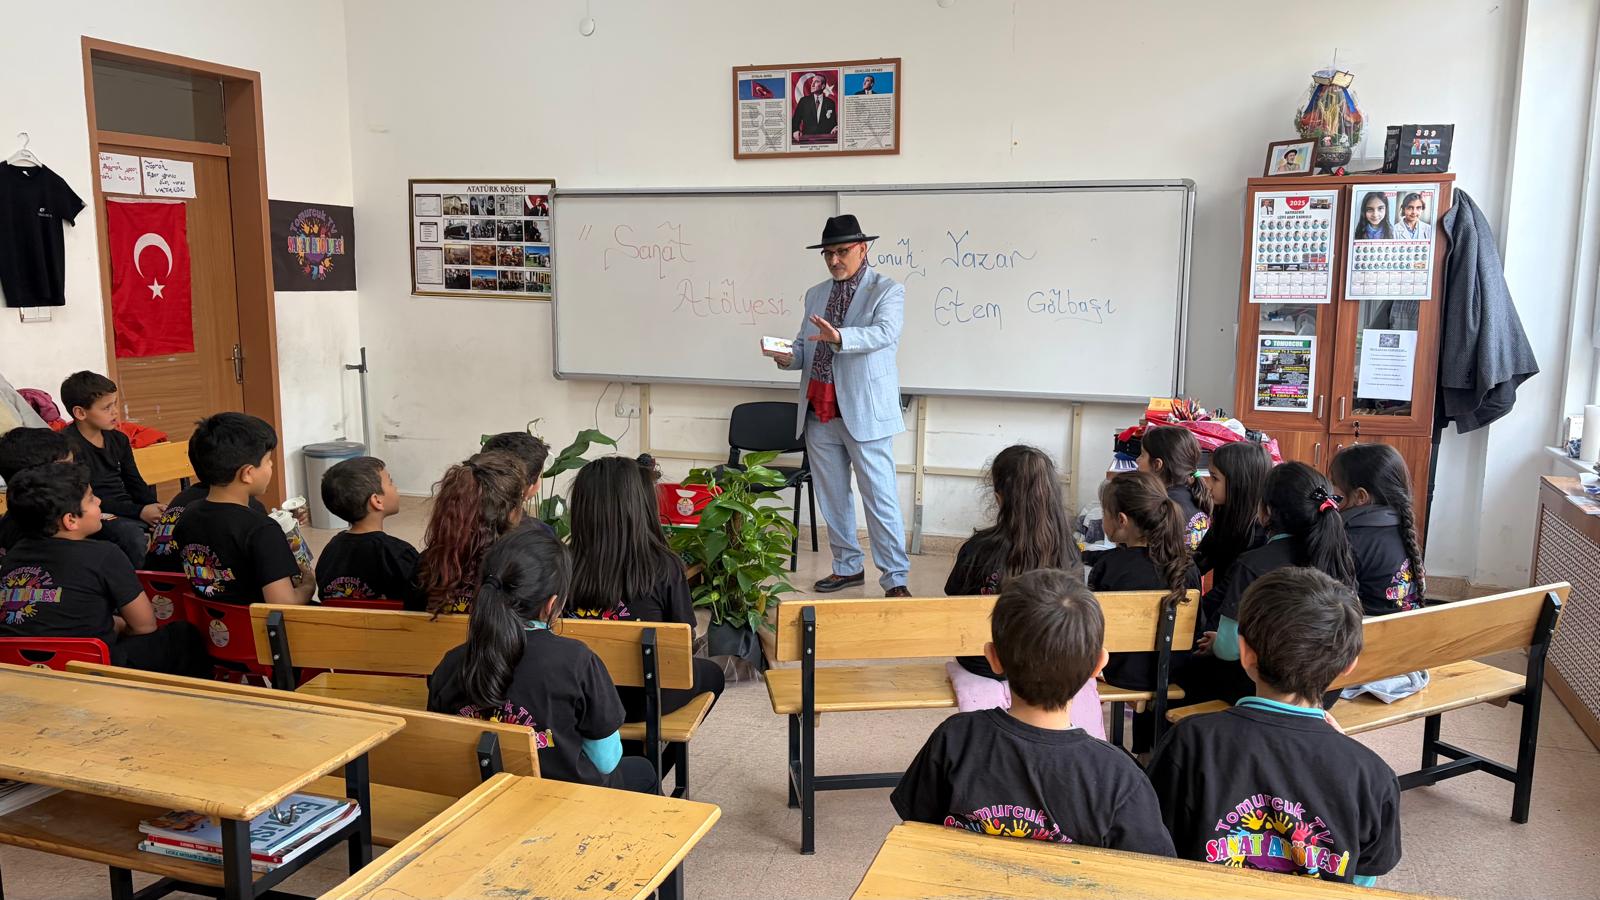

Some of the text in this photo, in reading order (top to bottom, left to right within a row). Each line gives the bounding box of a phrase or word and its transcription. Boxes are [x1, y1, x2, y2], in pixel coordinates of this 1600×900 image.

[466, 184, 526, 195] ATATÜRK KÖŞESİ
[934, 286, 1118, 330] Etem Gölbaşı
[1214, 793, 1335, 845] Tomurcuk TV
[1205, 833, 1265, 863] SANAT
